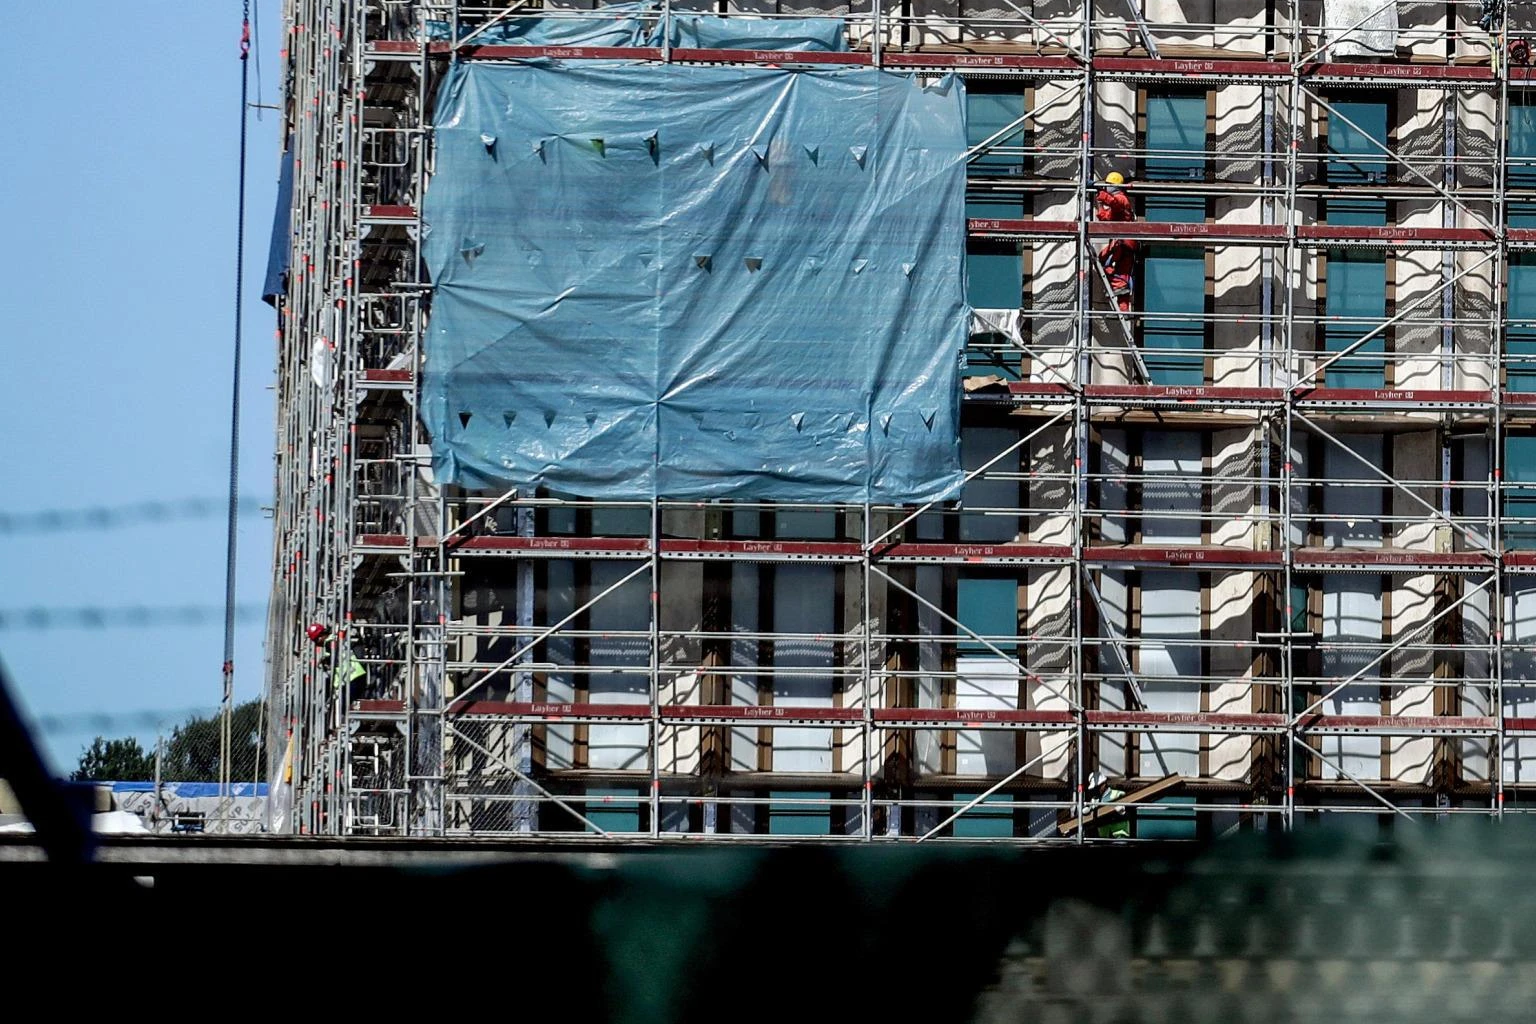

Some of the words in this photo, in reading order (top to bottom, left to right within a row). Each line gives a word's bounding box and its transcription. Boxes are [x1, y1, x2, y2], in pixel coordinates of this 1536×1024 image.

[755, 51, 783, 61] Layher
[1175, 61, 1203, 71] Layher
[1383, 67, 1411, 76] Layher
[1166, 387, 1194, 397] Layher
[1375, 391, 1403, 400] Layher
[530, 539, 558, 549] Layher
[743, 543, 771, 552] Layher
[955, 546, 983, 556] Layher
[532, 704, 560, 714] Layher
